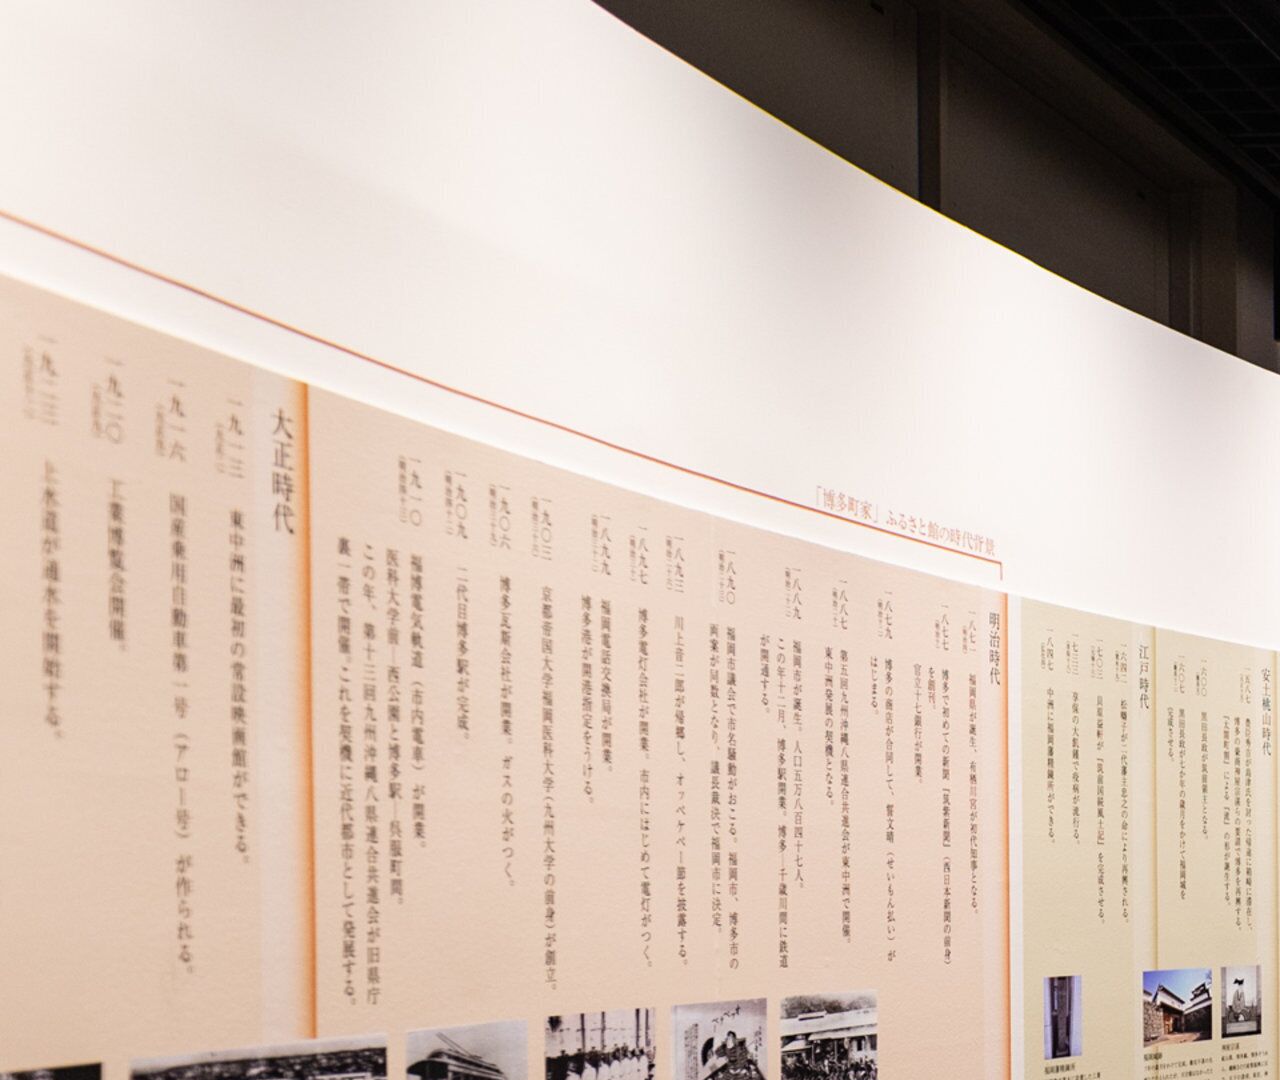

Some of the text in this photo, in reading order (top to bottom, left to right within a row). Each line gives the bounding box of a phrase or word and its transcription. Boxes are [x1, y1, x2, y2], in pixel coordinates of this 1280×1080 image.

[271, 405, 296, 537] 大正時代
[989, 611, 1001, 687] 明治時代
